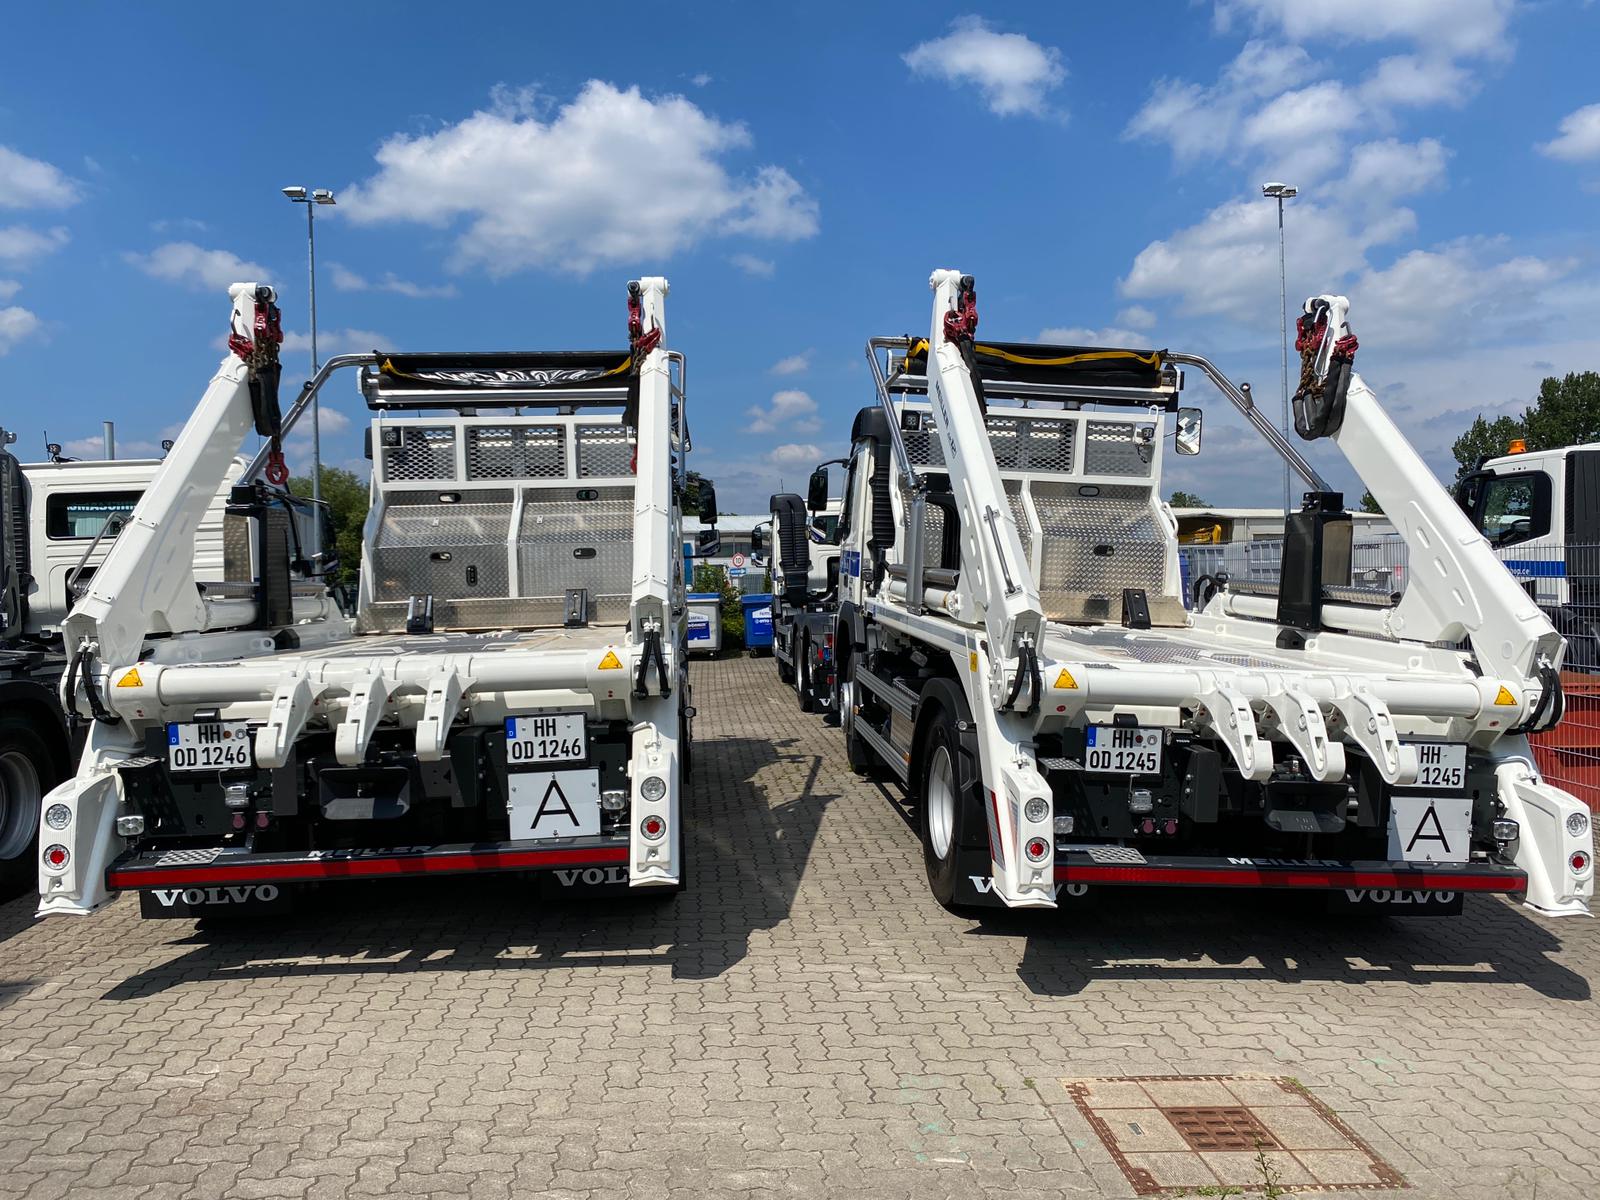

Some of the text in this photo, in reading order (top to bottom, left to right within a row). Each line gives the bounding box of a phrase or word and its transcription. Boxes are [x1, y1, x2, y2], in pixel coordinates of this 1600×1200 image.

[198, 724, 221, 744] HH
[534, 718, 556, 737] HH
[512, 738, 581, 760] OD 1246
[1112, 729, 1134, 749] HH
[174, 745, 247, 767] OD 1246
[1089, 750, 1157, 771] OD 1245
[1420, 745, 1441, 764] HH
[1421, 766, 1461, 786] 1245
[530, 779, 580, 830] A
[1405, 805, 1451, 853] A
[1227, 857, 1343, 867] MEILLER
[552, 865, 631, 887] VOL
[151, 884, 279, 907] VOLVO
[1345, 888, 1456, 904] VOLVO
